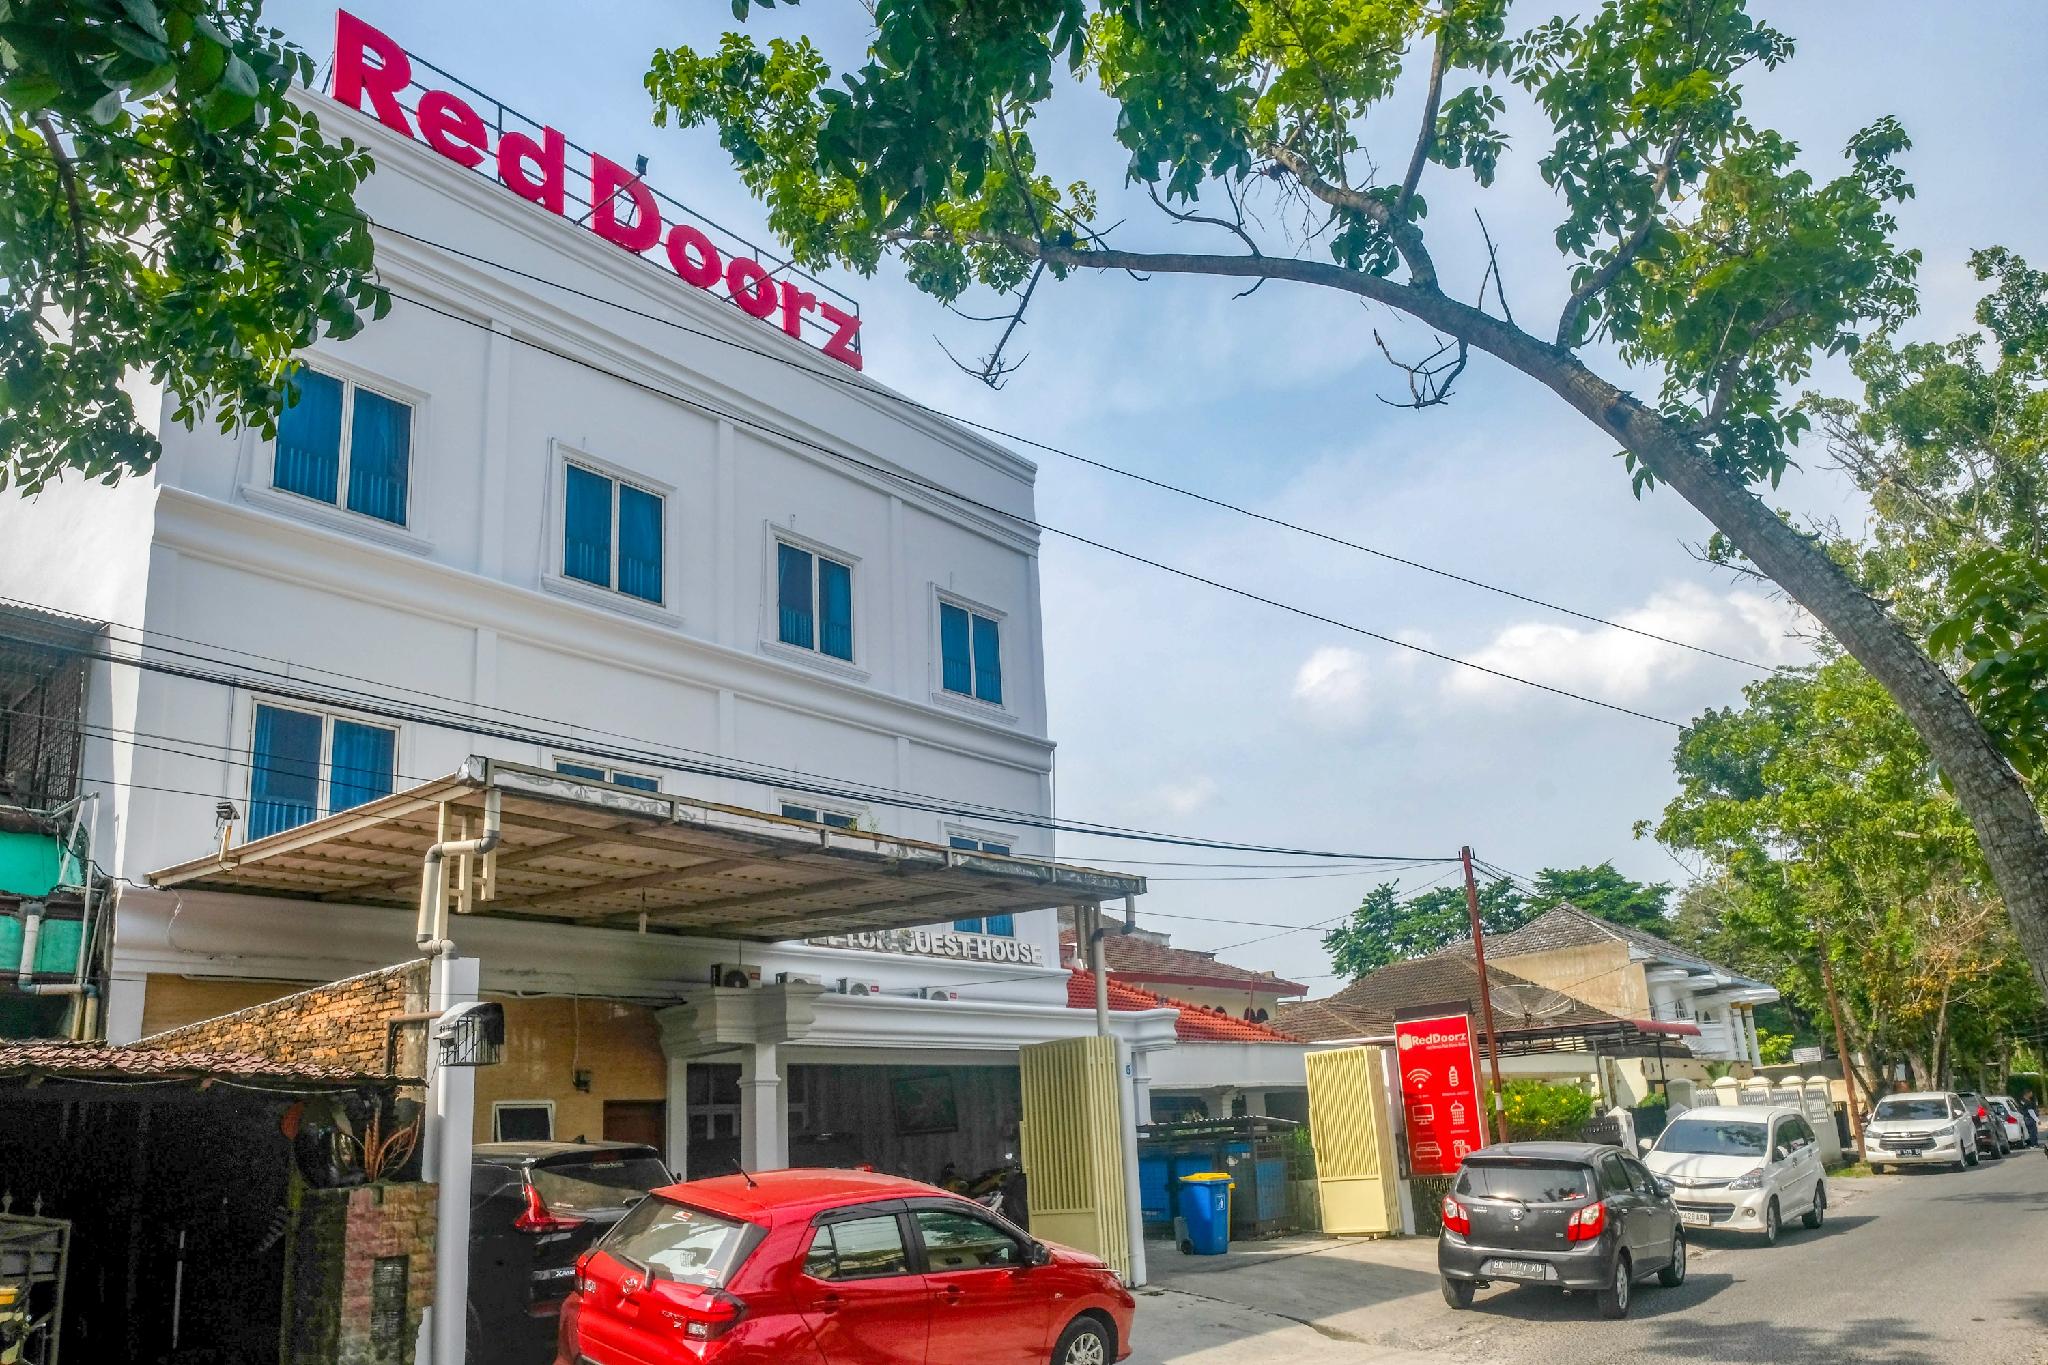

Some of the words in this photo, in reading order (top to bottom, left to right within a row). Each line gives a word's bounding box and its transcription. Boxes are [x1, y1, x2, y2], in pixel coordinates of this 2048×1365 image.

[332, 8, 863, 371] RedDoorz
[977, 937, 1042, 964] HOUSE
[1411, 1032, 1467, 1046] RedDoorz
